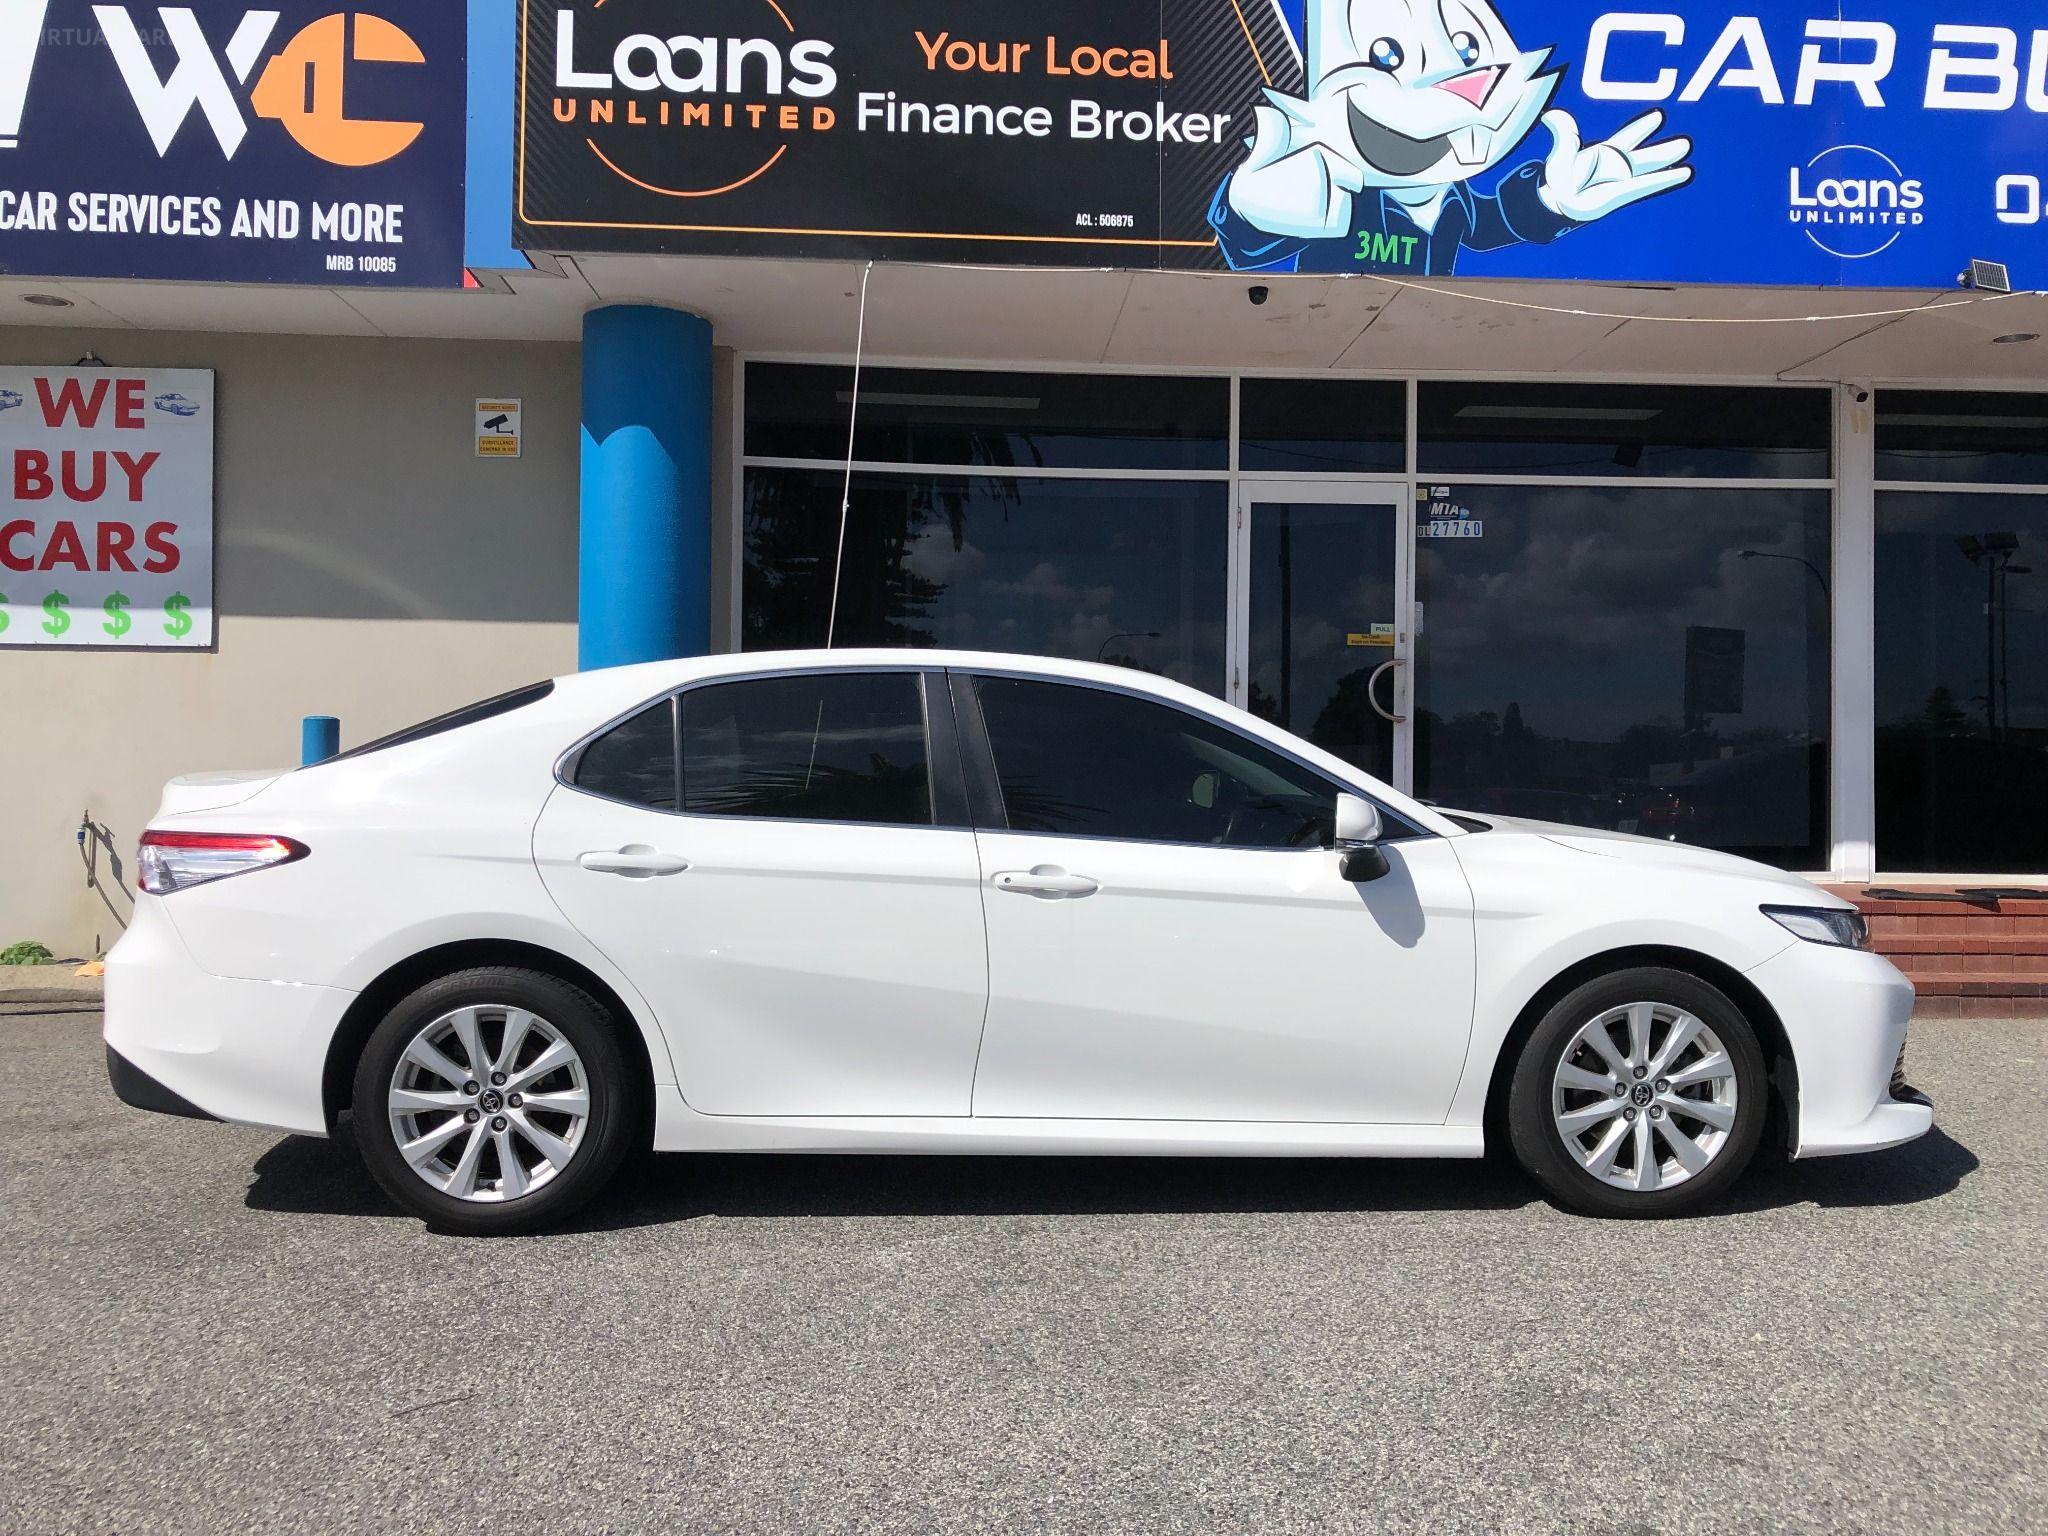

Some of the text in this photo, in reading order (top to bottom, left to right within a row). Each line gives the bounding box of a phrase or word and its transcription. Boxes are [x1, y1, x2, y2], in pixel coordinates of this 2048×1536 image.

[556, 9, 838, 97] Loans
[915, 31, 1173, 80] Your Local
[1581, 12, 1897, 108] CAR
[553, 98, 837, 130] UNLIMITED
[858, 92, 1231, 144] Finance Broker
[1790, 167, 1924, 209] Loans
[0, 190, 404, 244] CAR SERVICES AND MORE
[1099, 214, 1134, 228] 506875
[1789, 209, 1924, 225] UNLIMITED
[326, 254, 397, 273] MRB 10085
[1354, 230, 1418, 265] 3MT
[33, 377, 147, 430] WE
[14, 449, 162, 502] BUY
[1430, 502, 1459, 515] MTA
[1432, 521, 1481, 537] 27760
[0, 519, 182, 574] CARS
